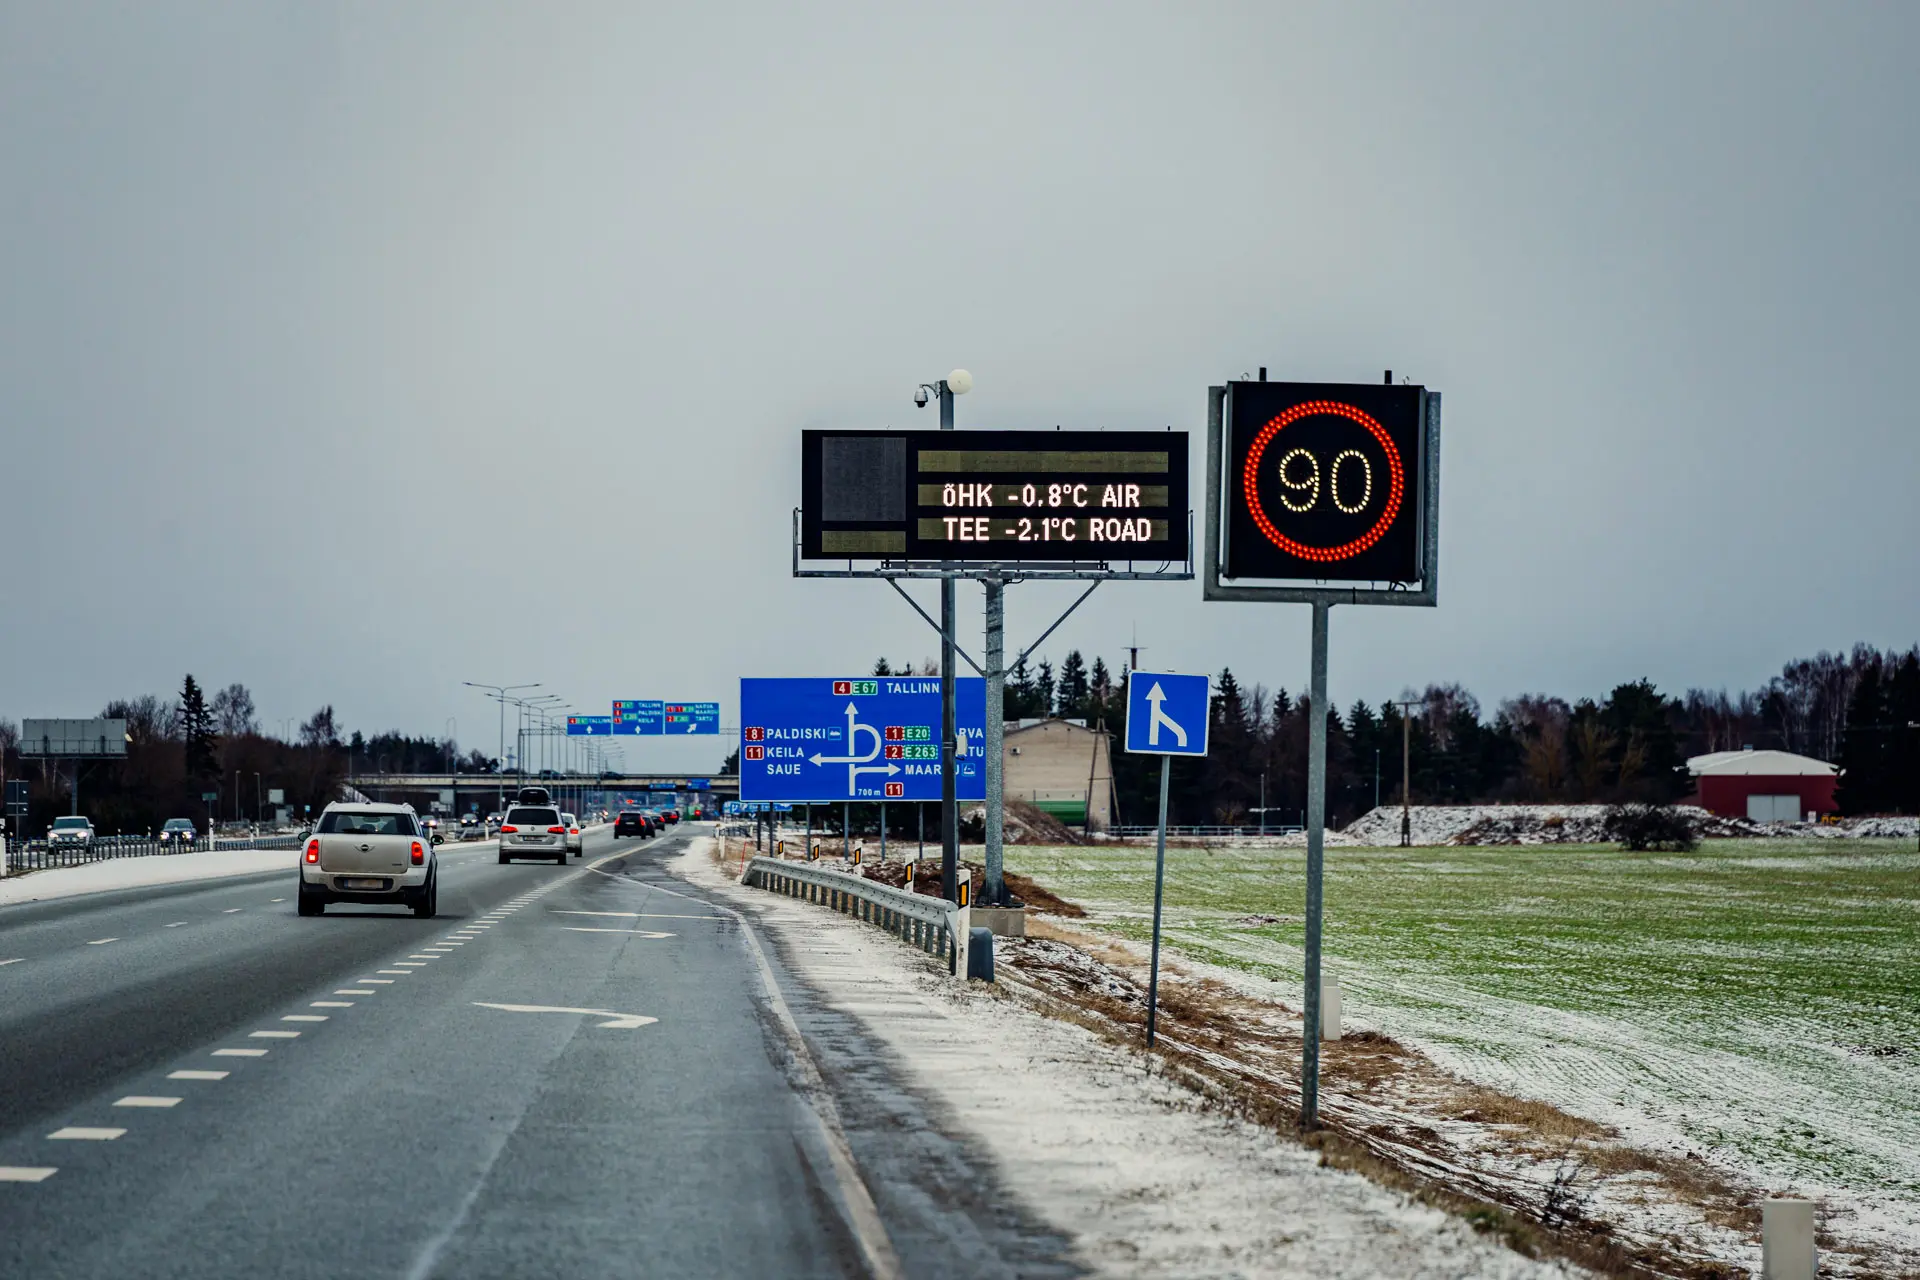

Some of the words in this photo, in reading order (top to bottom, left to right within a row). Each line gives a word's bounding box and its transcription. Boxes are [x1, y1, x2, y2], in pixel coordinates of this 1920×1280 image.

[1279, 448, 1372, 514] 90
[1101, 484, 1140, 507] AIR
[942, 518, 990, 541] TEE
[1089, 517, 1152, 541] ROAD
[838, 683, 846, 693] 4
[886, 682, 940, 693] TALLINN
[751, 729, 758, 739] 8
[766, 728, 826, 739] PALDISKI
[748, 747, 762, 758] 11
[766, 747, 805, 758] KEILA
[891, 747, 898, 757] 2
[766, 763, 801, 775] SAUE
[857, 788, 873, 796] 700
[887, 784, 901, 795] 11
